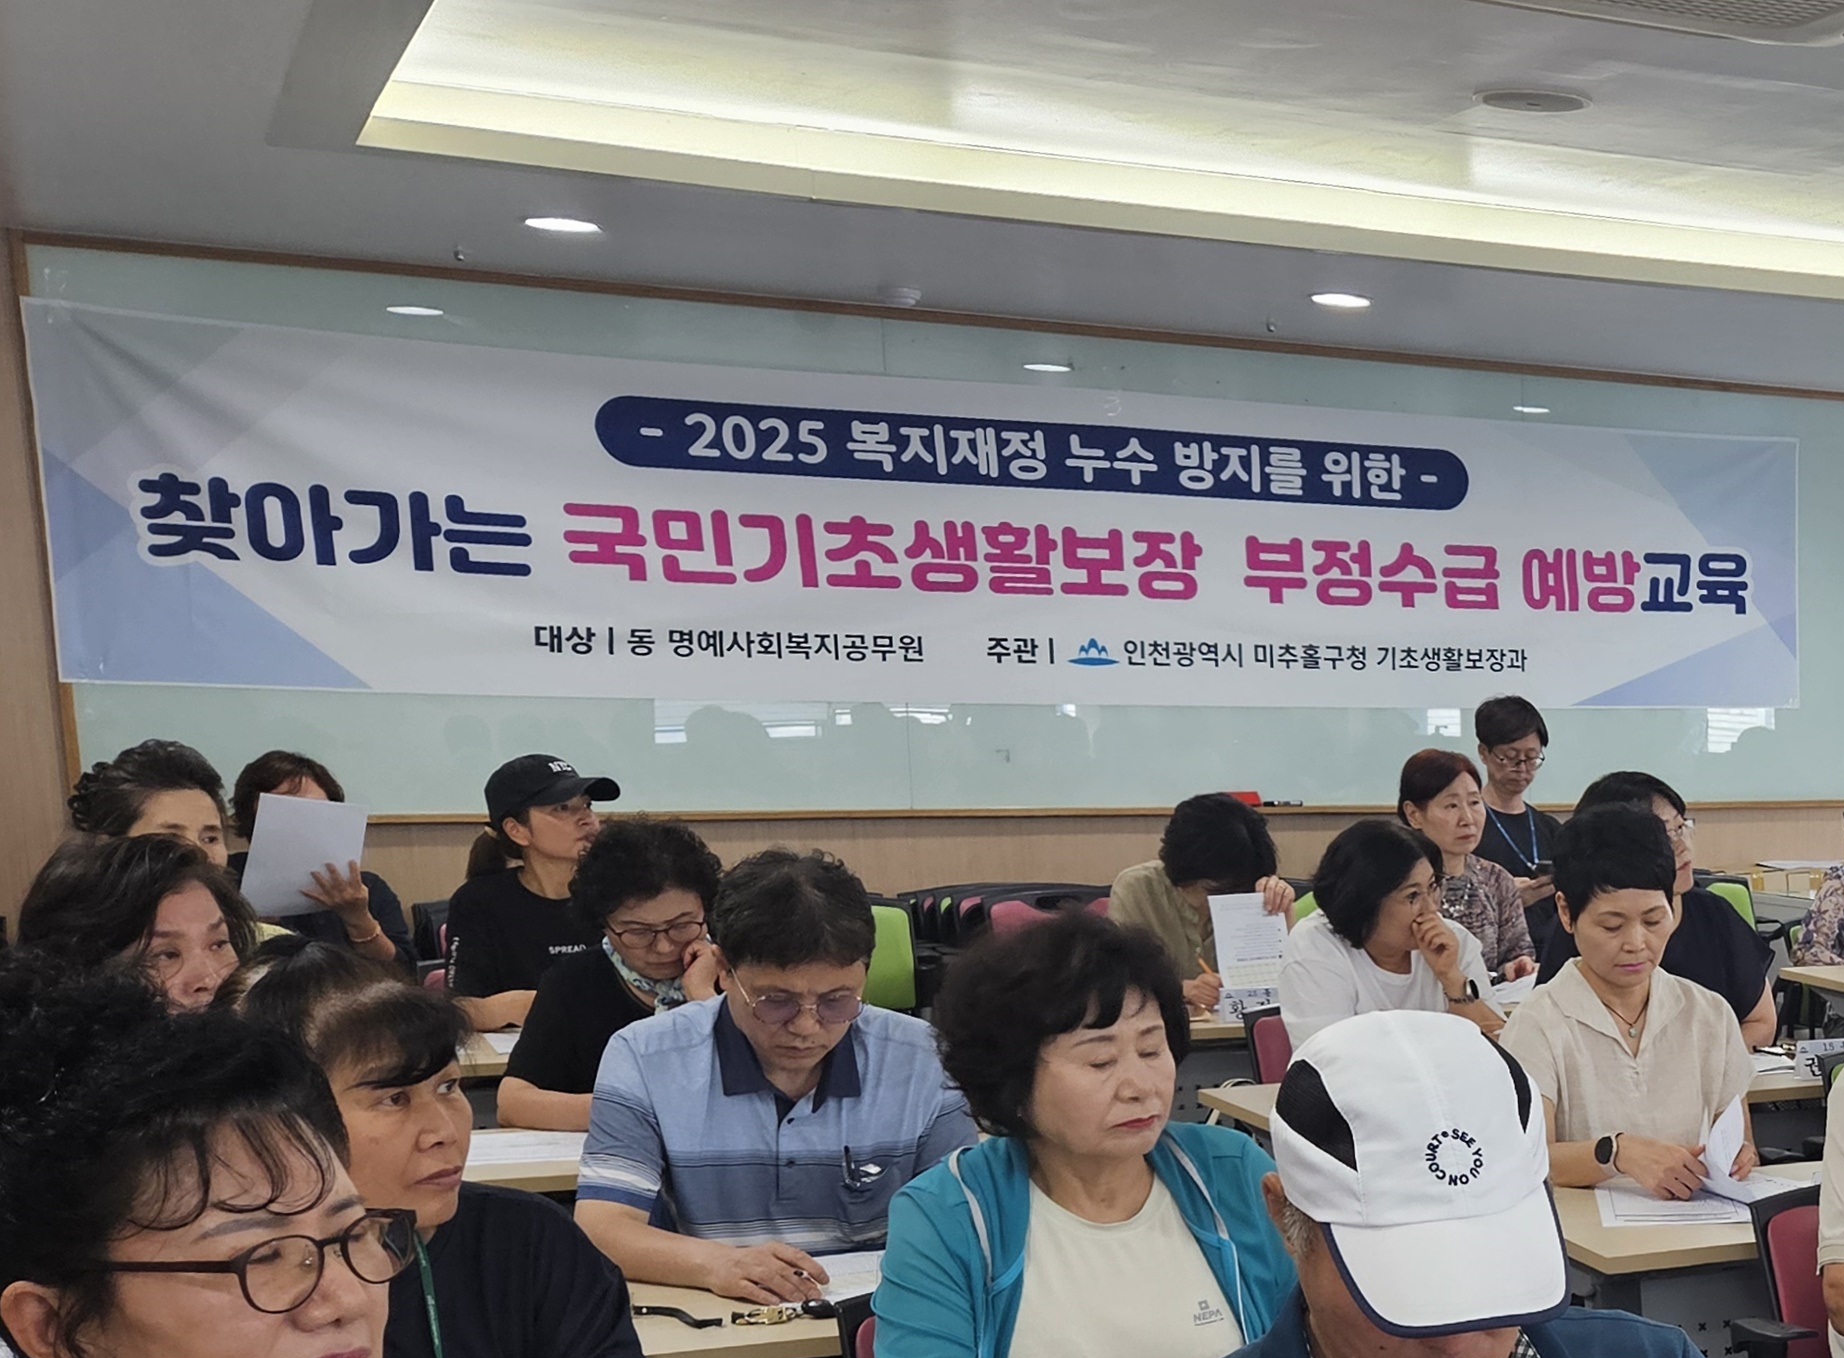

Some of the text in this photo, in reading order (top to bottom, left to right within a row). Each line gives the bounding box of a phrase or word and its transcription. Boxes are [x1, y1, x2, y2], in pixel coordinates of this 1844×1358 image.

[684, 413, 828, 466] 2025
[846, 420, 1047, 482] 복지재정
[1065, 433, 1159, 487] 누수
[1174, 440, 1309, 498] 방지를
[1321, 450, 1407, 502] 위한
[138, 472, 1749, 616] 찾아가는 국민기초생활보장 부정수급 예방교육
[534, 625, 925, 664] 대상 동 명예사회복지공무원
[987, 637, 1529, 674] 주관 인천광역시 미추홀구청 기초생활보장과
[1823, 1042, 1834, 1052] 15
[1424, 1128, 1483, 1186] SEE YOU ON COURT
[1193, 1308, 1223, 1323] NEPA
